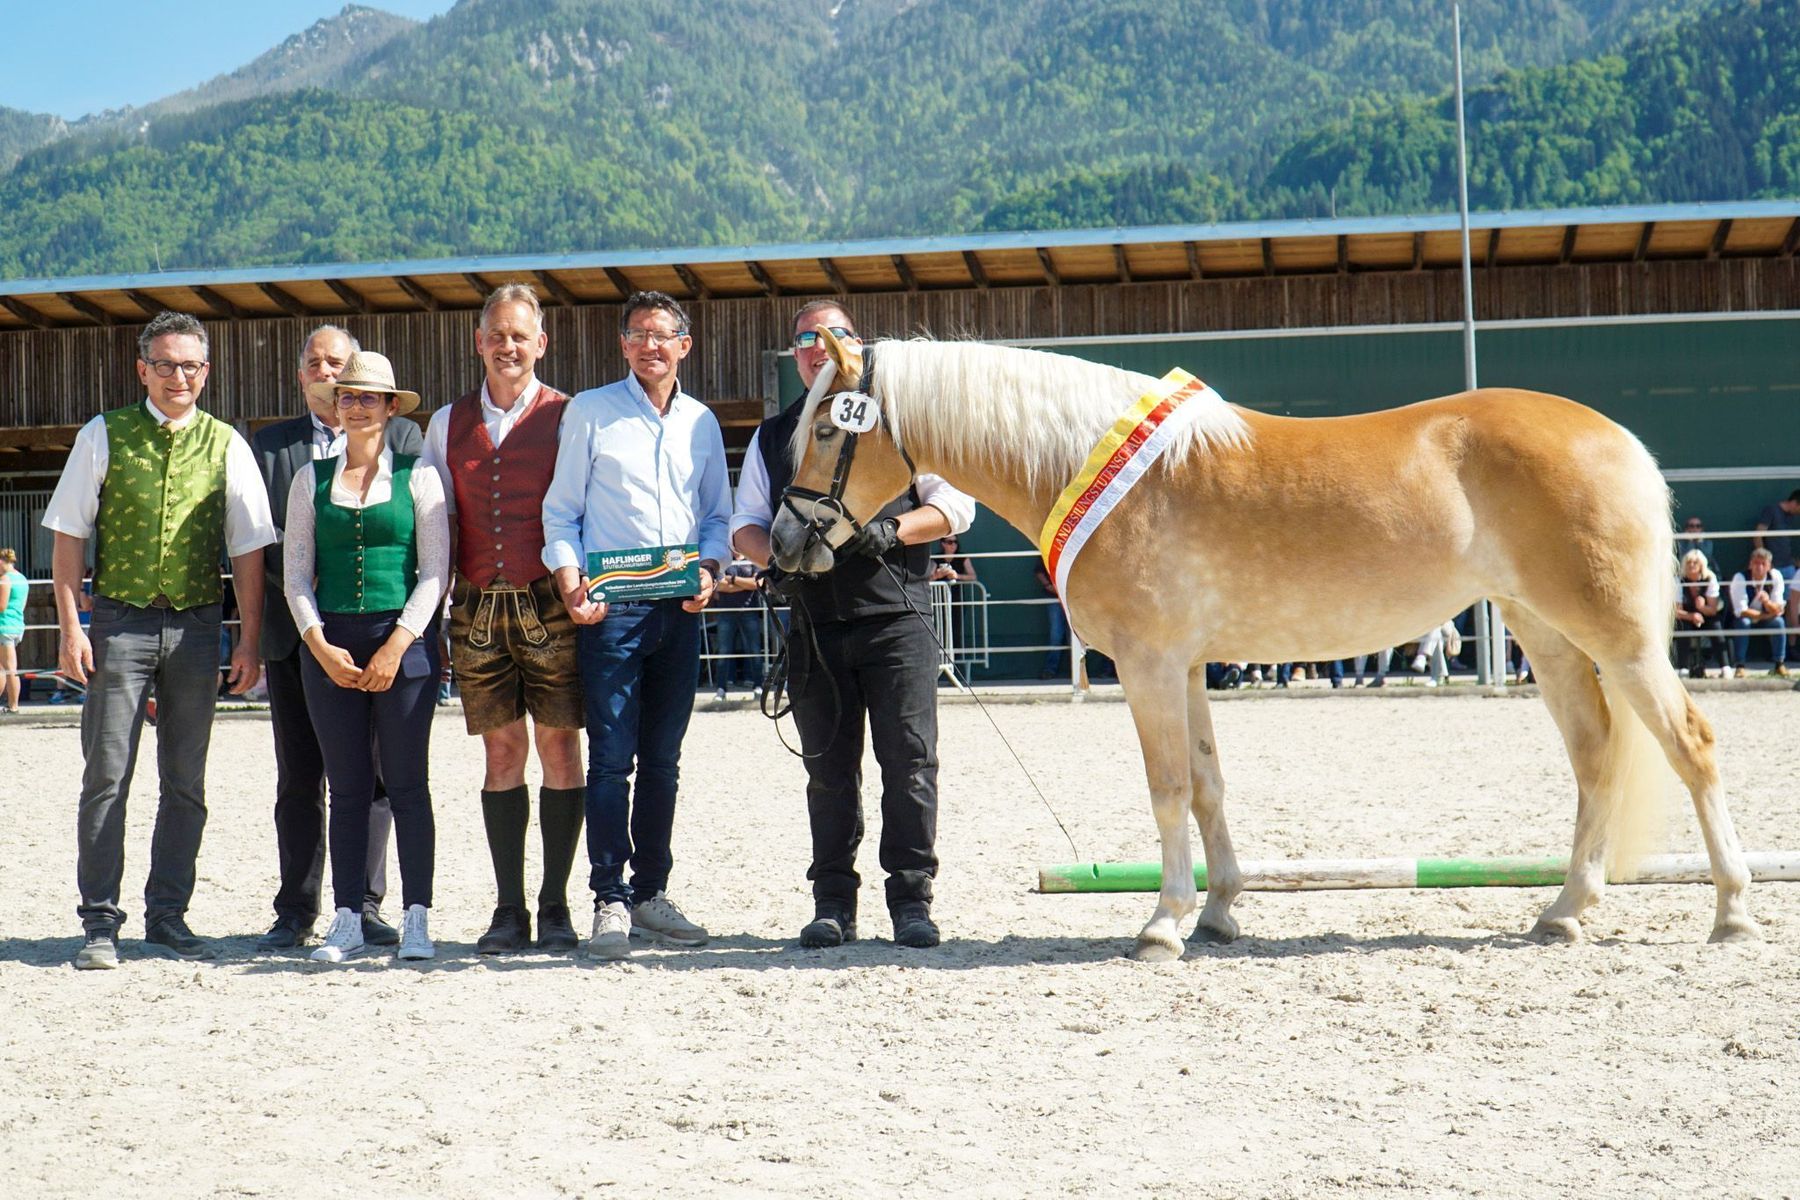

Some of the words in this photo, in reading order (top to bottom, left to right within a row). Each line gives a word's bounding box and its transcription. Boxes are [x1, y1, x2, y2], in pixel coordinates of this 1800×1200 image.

[840, 398, 867, 425] 34
[1053, 433, 1143, 552] LANDESJUNGSTUTENSCHAU
[602, 554, 652, 566] HAFLINGER
